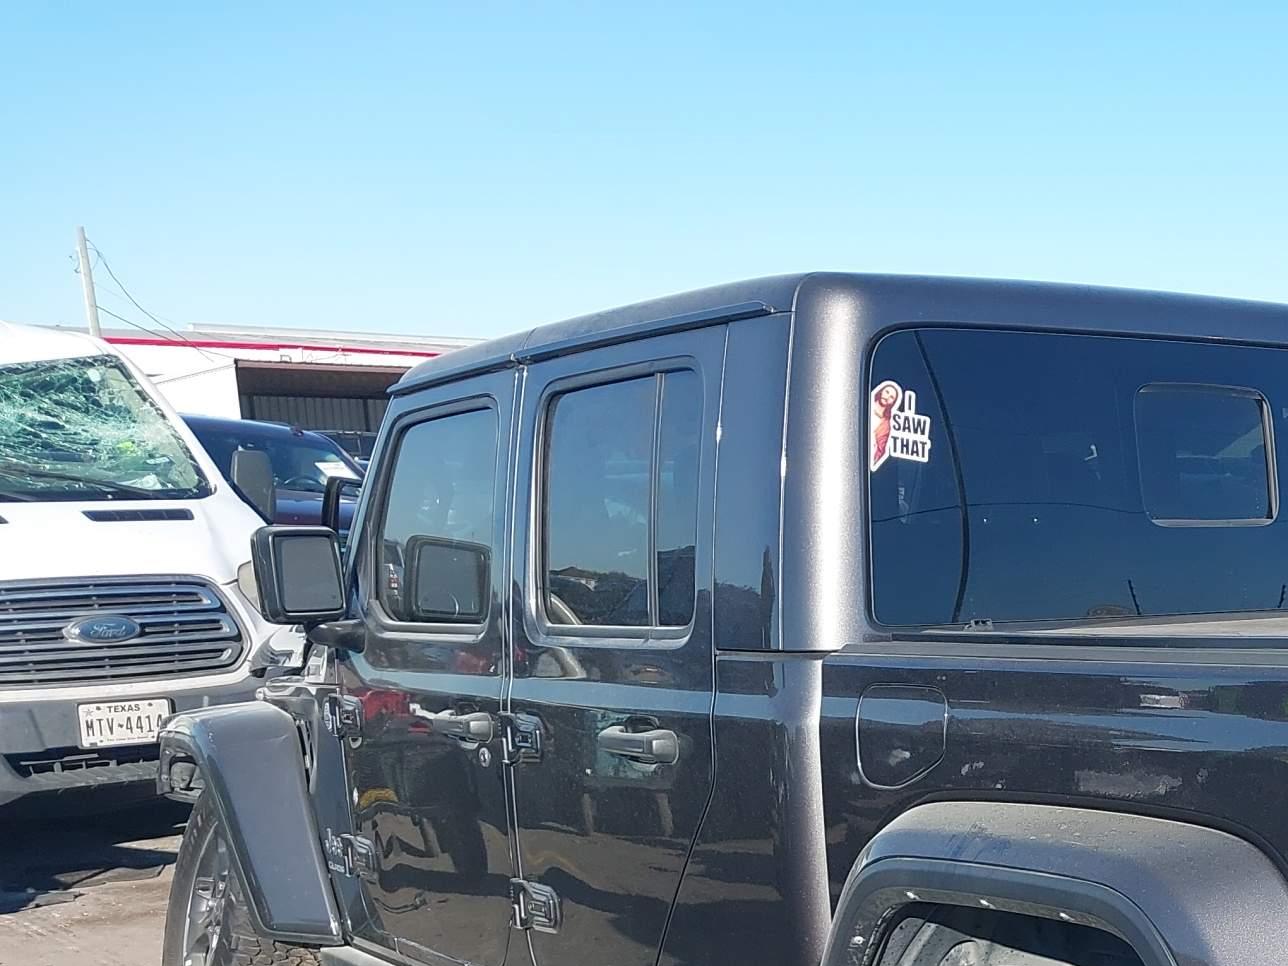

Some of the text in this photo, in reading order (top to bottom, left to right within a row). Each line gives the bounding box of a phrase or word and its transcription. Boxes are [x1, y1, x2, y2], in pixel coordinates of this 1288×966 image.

[892, 413, 927, 435] SAW
[891, 436, 927, 458] THAT
[90, 623, 127, 639] Ford
[107, 703, 140, 713] TEXAS
